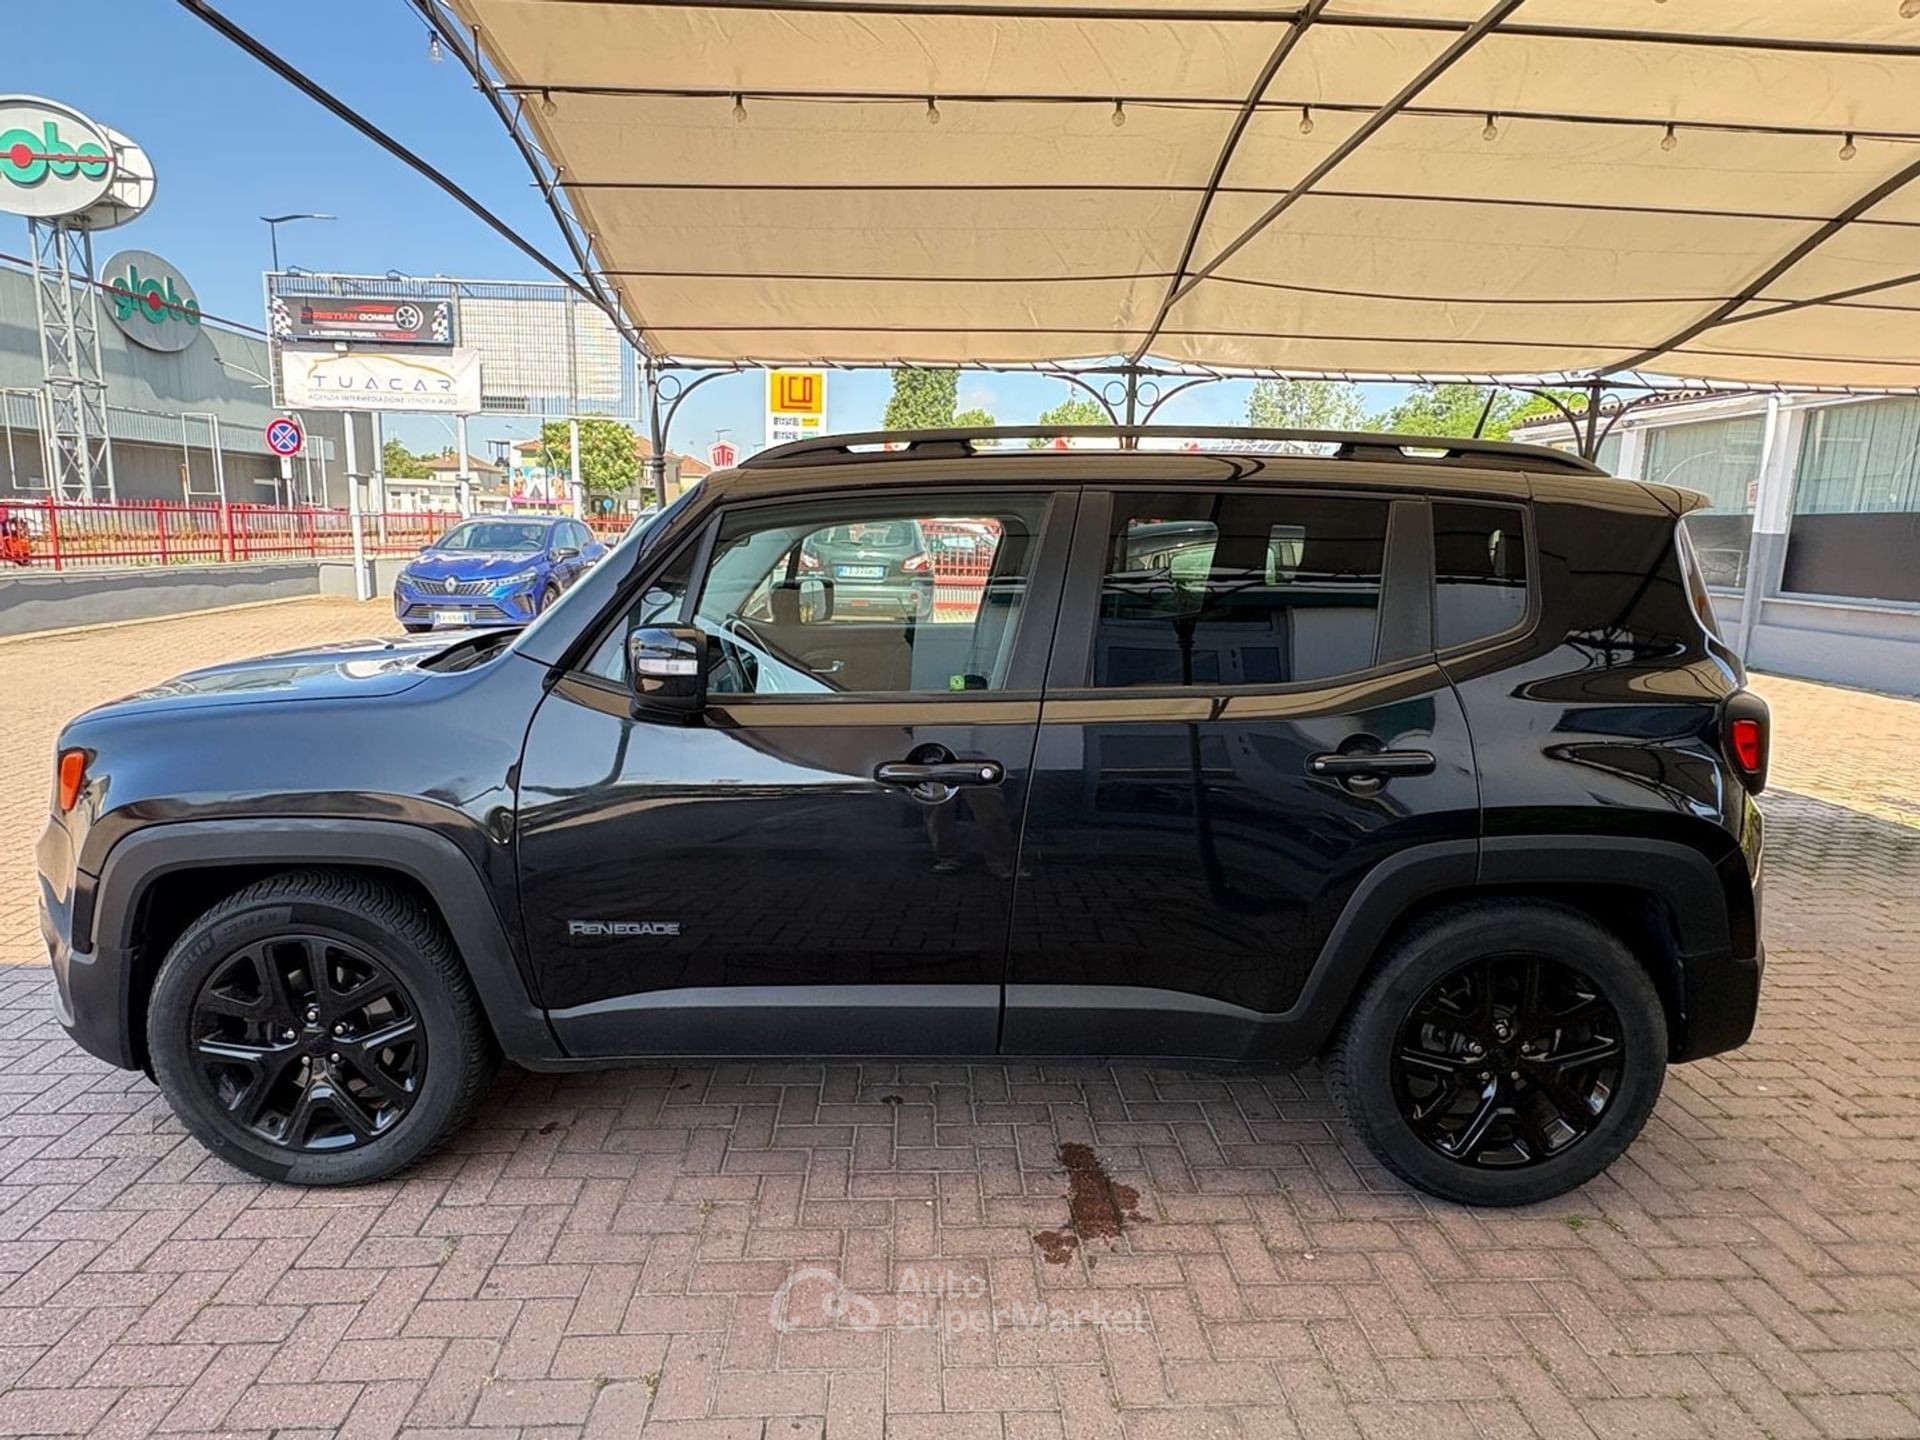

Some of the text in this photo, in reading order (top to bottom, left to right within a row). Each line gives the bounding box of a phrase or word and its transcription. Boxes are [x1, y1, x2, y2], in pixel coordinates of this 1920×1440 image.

[0, 121, 109, 184] obo
[111, 264, 200, 325] globo
[359, 311, 394, 322] GOMME
[312, 375, 452, 392] TUACAR
